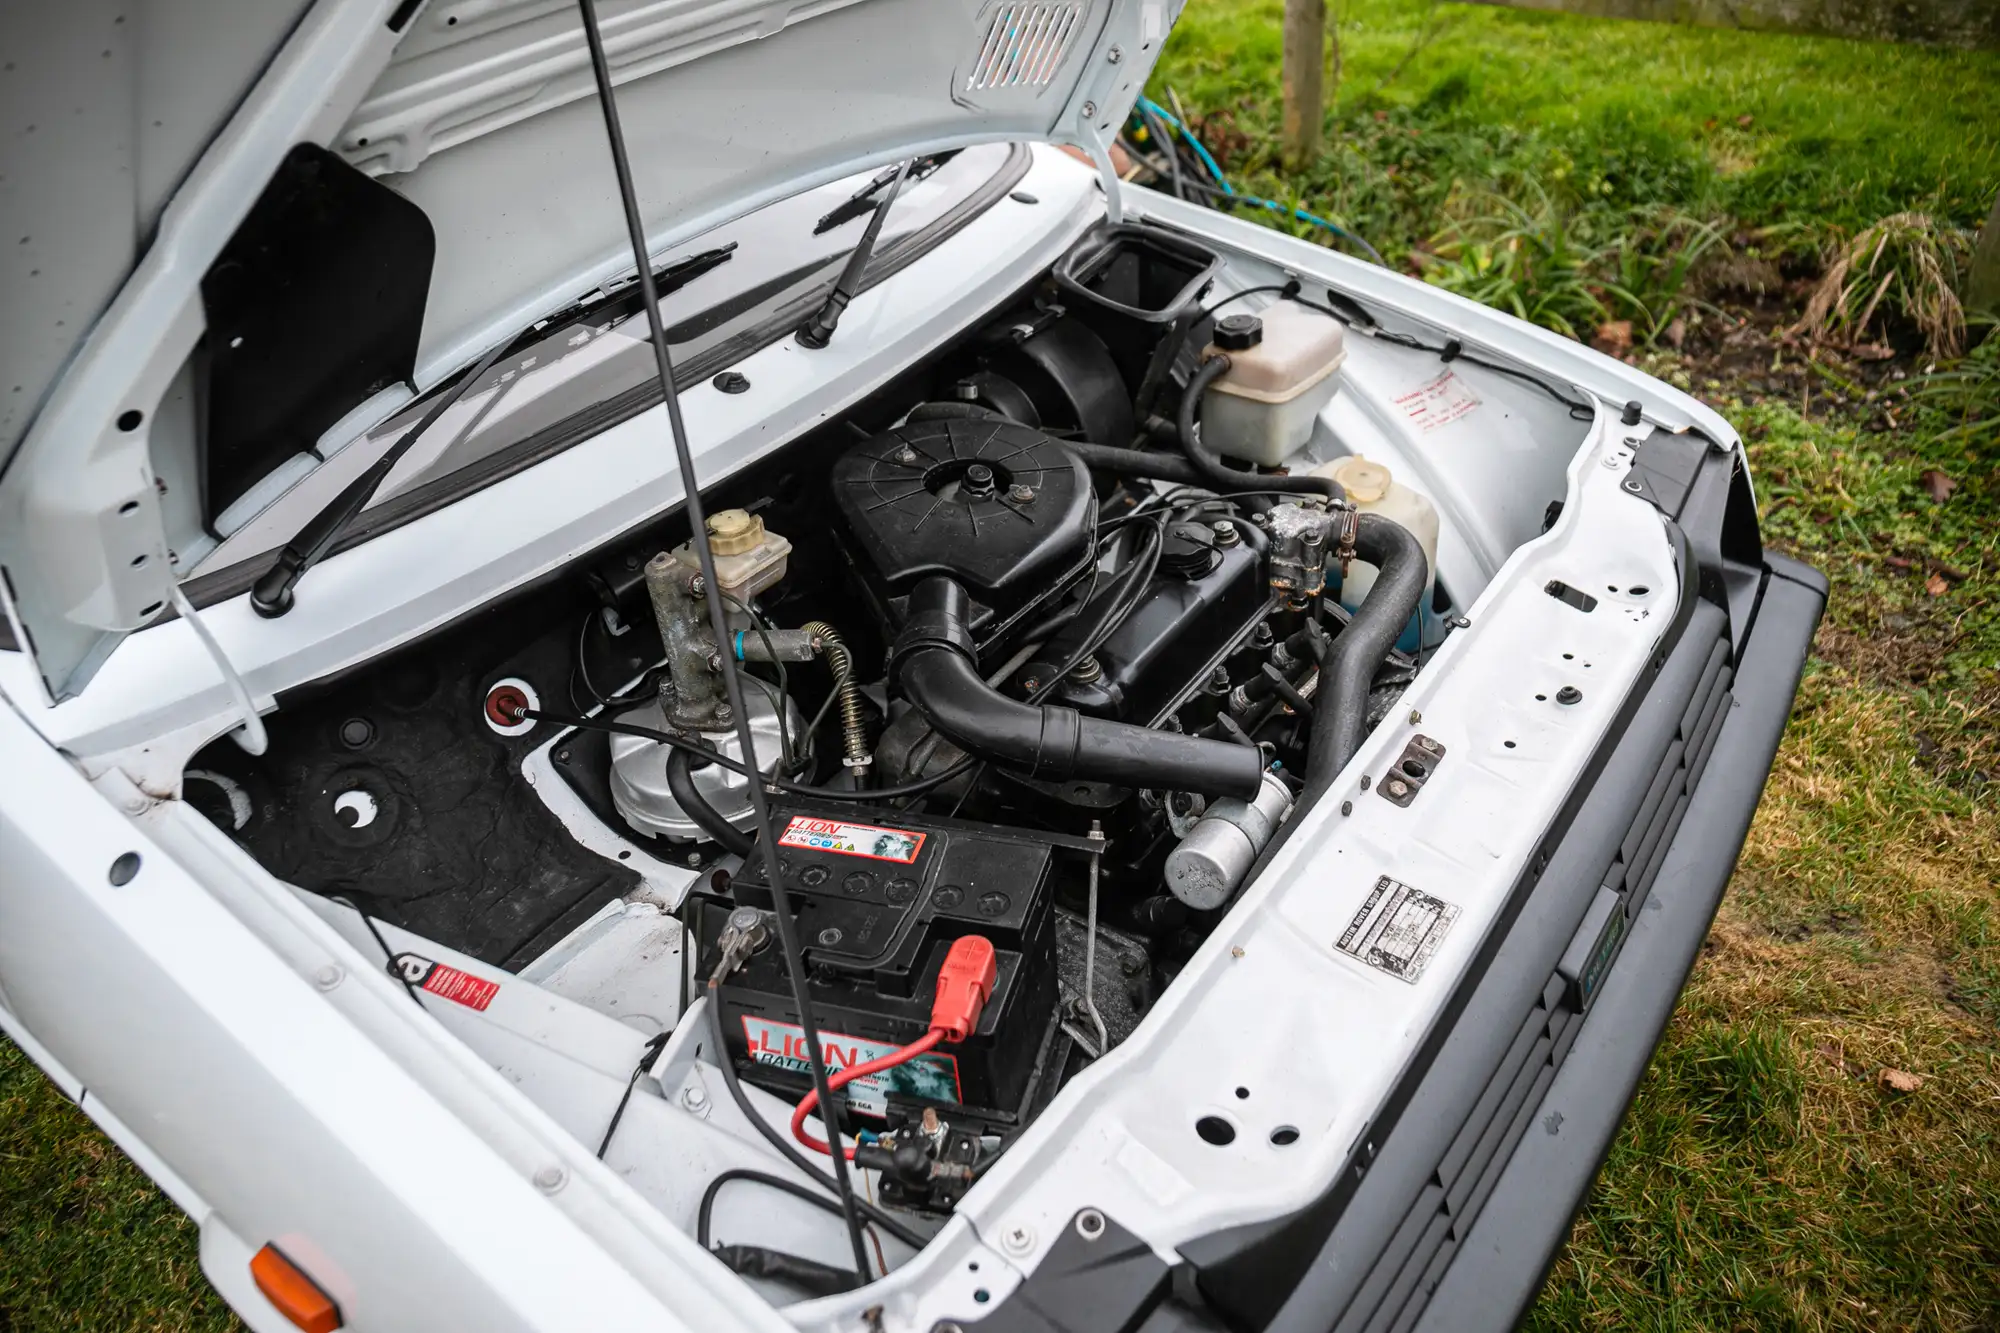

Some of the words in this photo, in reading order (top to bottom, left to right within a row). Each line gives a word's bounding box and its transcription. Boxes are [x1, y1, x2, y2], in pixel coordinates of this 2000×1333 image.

[790, 829, 832, 839] BATTERIES
[796, 819, 842, 834] LION
[1340, 926, 1358, 946] AUSTIN
[1354, 906, 1370, 926] ROVER
[1366, 889, 1381, 907] GROUP
[1379, 879, 1389, 891] LTD
[760, 1030, 858, 1068] LION
